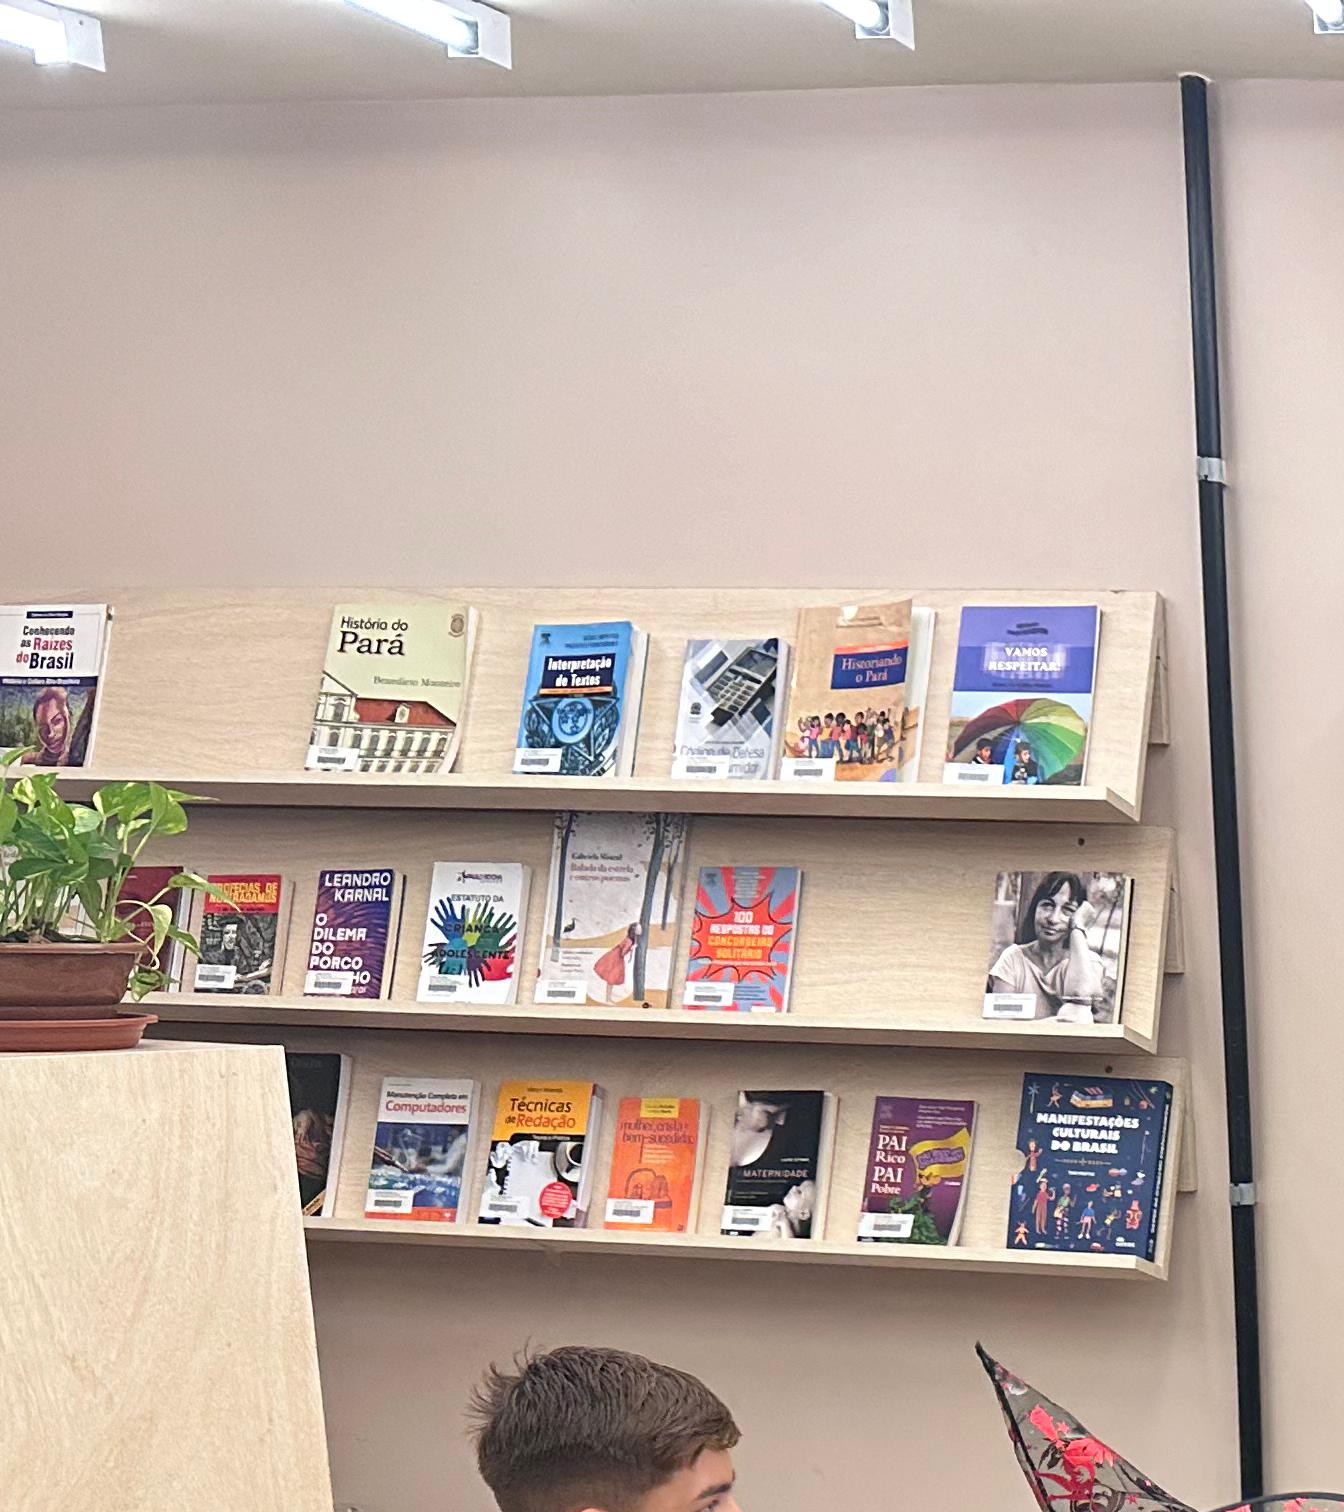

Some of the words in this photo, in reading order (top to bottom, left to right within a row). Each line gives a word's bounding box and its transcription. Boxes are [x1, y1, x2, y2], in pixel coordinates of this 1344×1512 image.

[341, 616, 387, 630] História
[391, 618, 408, 631] do
[23, 626, 75, 636] Conhecendo
[20, 639, 31, 648] as
[33, 637, 73, 651] Raízes
[337, 630, 405, 656] Pará
[1005, 646, 1048, 657] VAMOS
[16, 651, 29, 664] do
[29, 652, 74, 670] Brasil
[548, 656, 612, 672] Interpretação
[842, 654, 902, 671] Historiando
[988, 660, 1061, 672] RESPEITAR!
[556, 674, 568, 686] de
[570, 673, 601, 687] Textos
[865, 670, 888, 682] Pará
[325, 873, 391, 887] LEANDRO
[334, 888, 389, 902] KARNAL
[451, 893, 491, 903] ESTATUTO
[493, 895, 504, 903] DA
[316, 912, 327, 926] O
[733, 911, 753, 924] 100
[313, 928, 368, 941] DILEMA
[311, 942, 334, 955] DO
[433, 949, 511, 960] ADOLESCENTE
[309, 956, 363, 971] PORCO
[386, 1091, 427, 1101] Manutenção
[427, 1092, 457, 1100] Completa
[385, 1101, 466, 1116] Computadores
[510, 1096, 571, 1113] Técnicas
[505, 1115, 516, 1125] de
[516, 1113, 576, 1130] Redação
[1037, 1112, 1139, 1129] MANIFESTAÇÕES
[1052, 1127, 1121, 1141] CULTURAIS
[878, 1135, 908, 1152] PAI
[1051, 1138, 1069, 1152] DO
[1071, 1139, 1118, 1154] BRASIL
[876, 1151, 906, 1164] Rico
[743, 1169, 809, 1179] MATERNIDADE
[872, 1166, 904, 1184] PAI
[870, 1183, 901, 1196] Pobre
